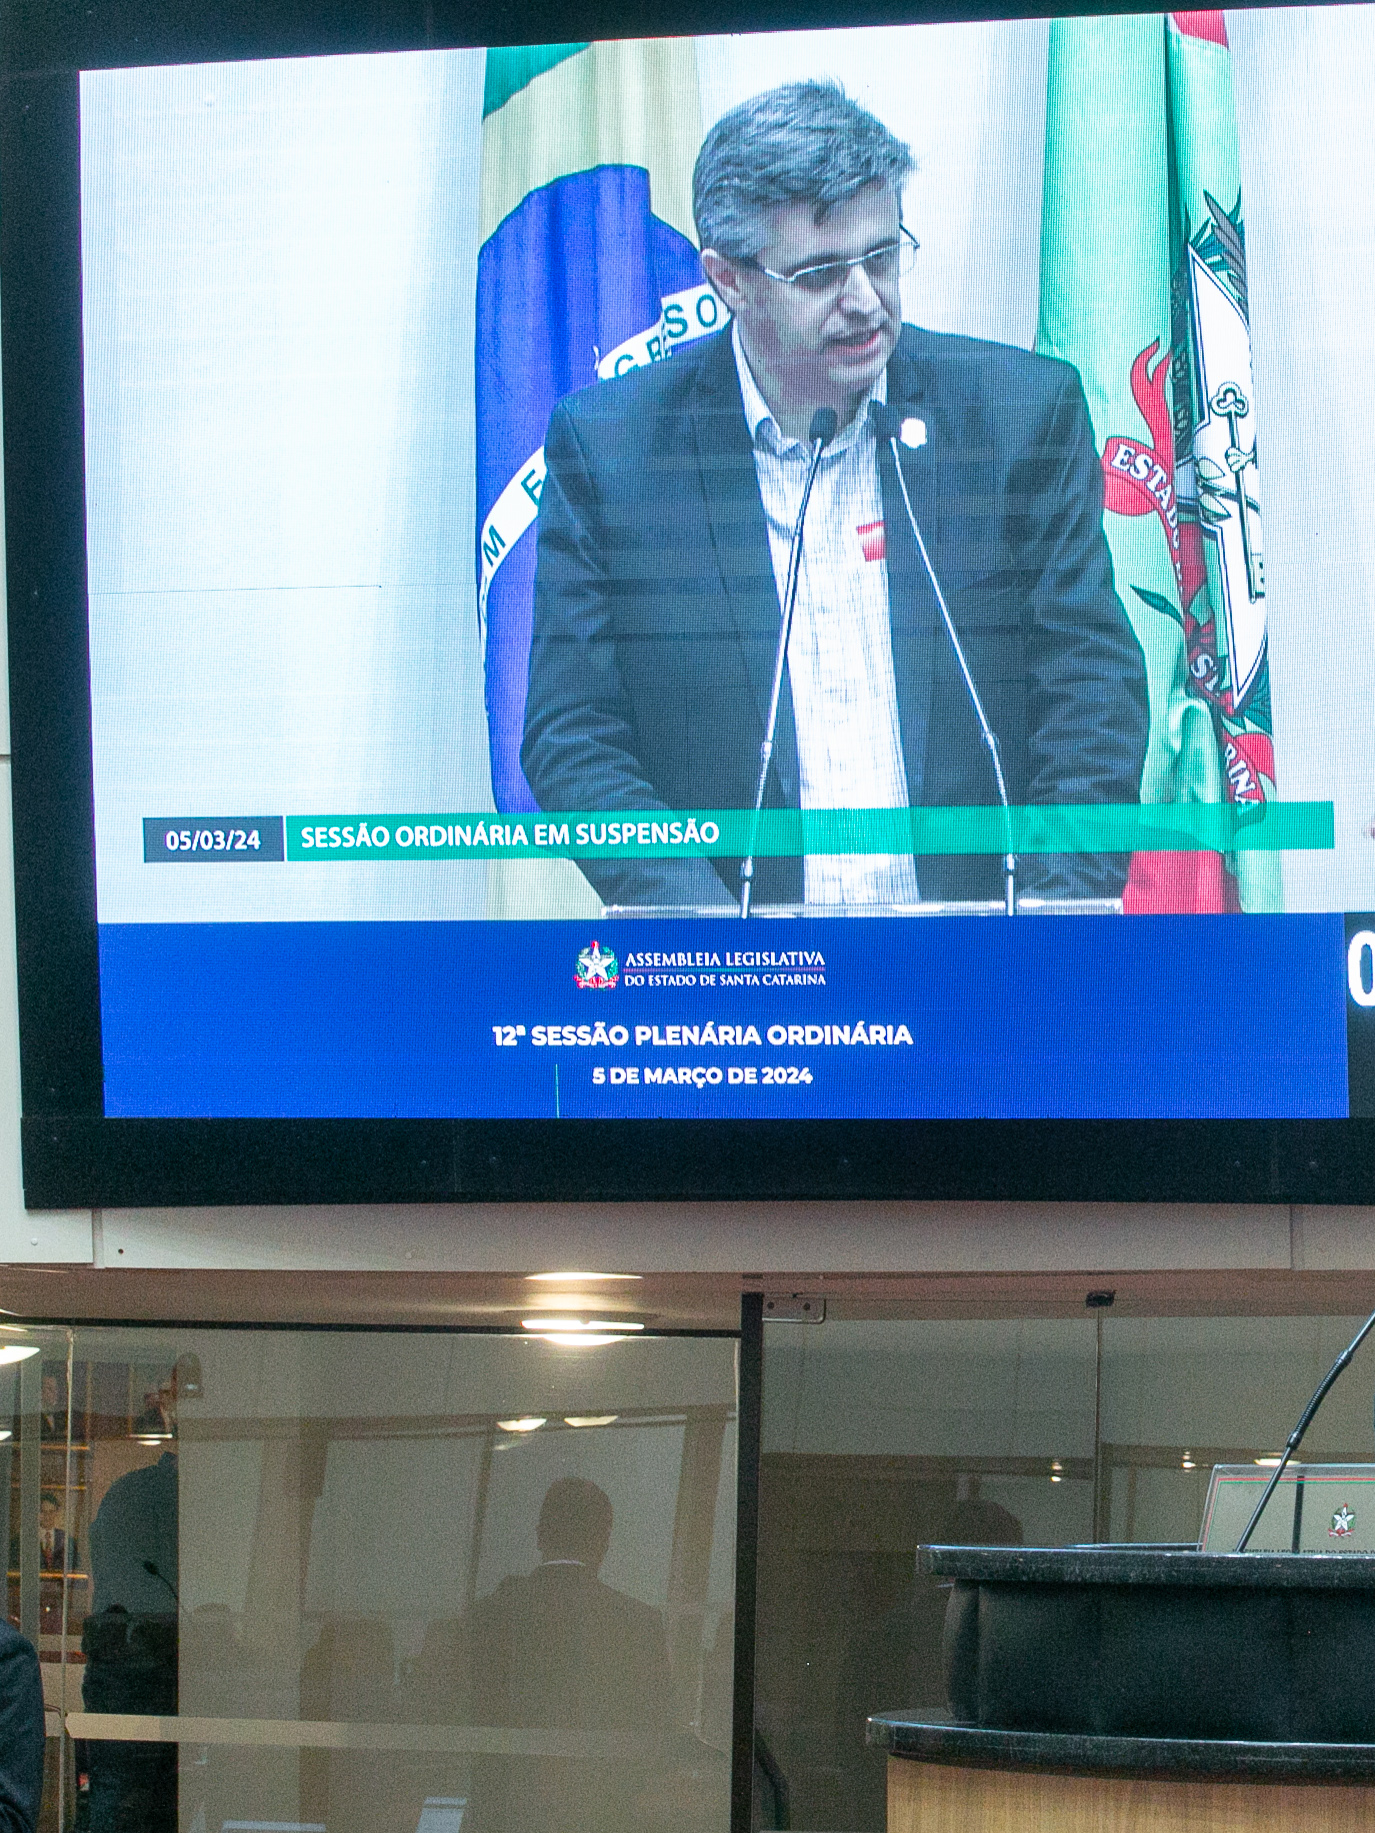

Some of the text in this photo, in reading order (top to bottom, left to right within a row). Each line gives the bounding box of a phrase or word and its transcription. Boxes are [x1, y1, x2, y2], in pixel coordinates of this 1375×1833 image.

[165, 829, 261, 851] 05/03/24
[301, 818, 720, 848] SESSÃO ORDINÁRIA EM SUSPENSÃO
[625, 950, 826, 967] ASSEMBLEIA LEGISLATIVA
[624, 973, 826, 987] DO ESTADO DE SANTA CATARINA
[531, 1022, 629, 1046] SESSÃO
[634, 1021, 763, 1046] PLENÁRIA
[767, 1020, 914, 1046] ORDINÁRIA
[592, 1066, 814, 1089] 5 DE MARÇO DE 2024
